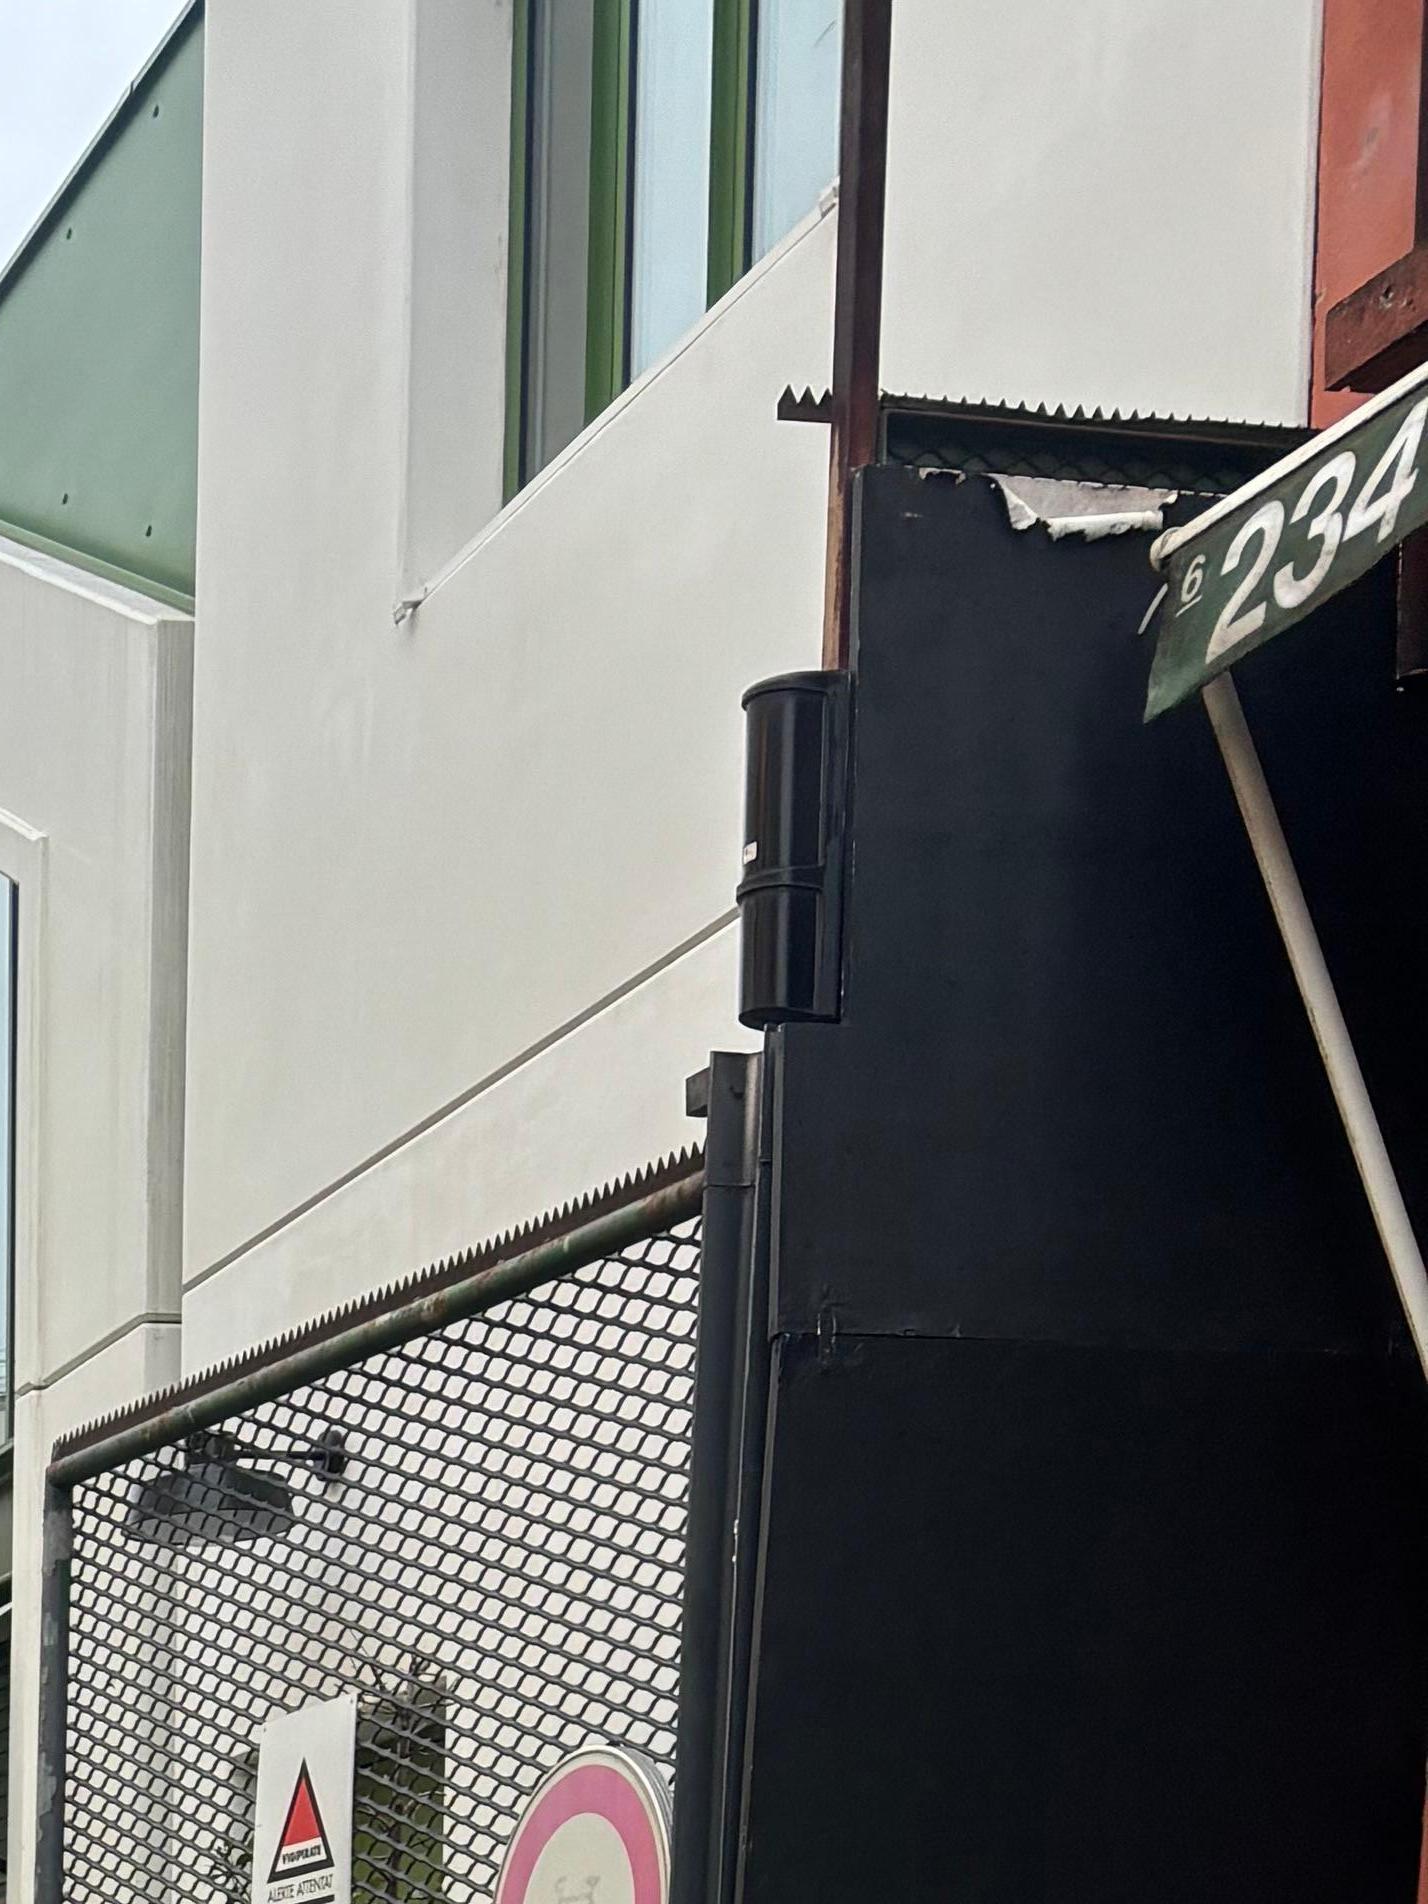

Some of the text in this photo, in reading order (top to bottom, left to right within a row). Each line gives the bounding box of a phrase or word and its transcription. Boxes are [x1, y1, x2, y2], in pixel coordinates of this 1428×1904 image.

[1180, 397, 1428, 665] 6 234
[267, 1873, 334, 1904] ALERTE ATTENTAT
